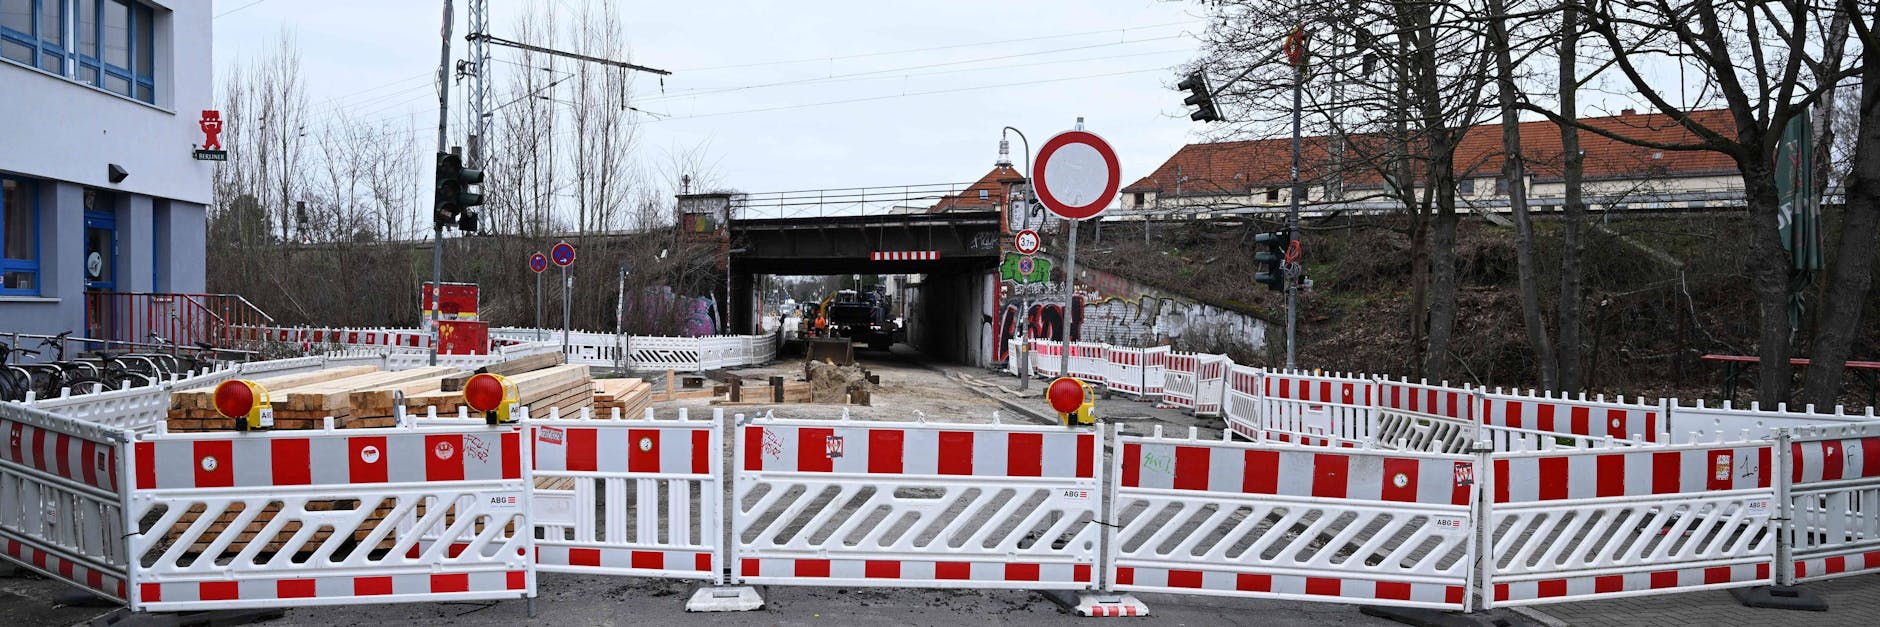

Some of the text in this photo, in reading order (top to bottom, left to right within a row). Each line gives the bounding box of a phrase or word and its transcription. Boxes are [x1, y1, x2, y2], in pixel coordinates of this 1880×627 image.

[198, 152, 225, 160] BERLINER
[1063, 490, 1079, 498] ABG
[490, 496, 507, 504] ABG
[1437, 519, 1452, 527] ABG
